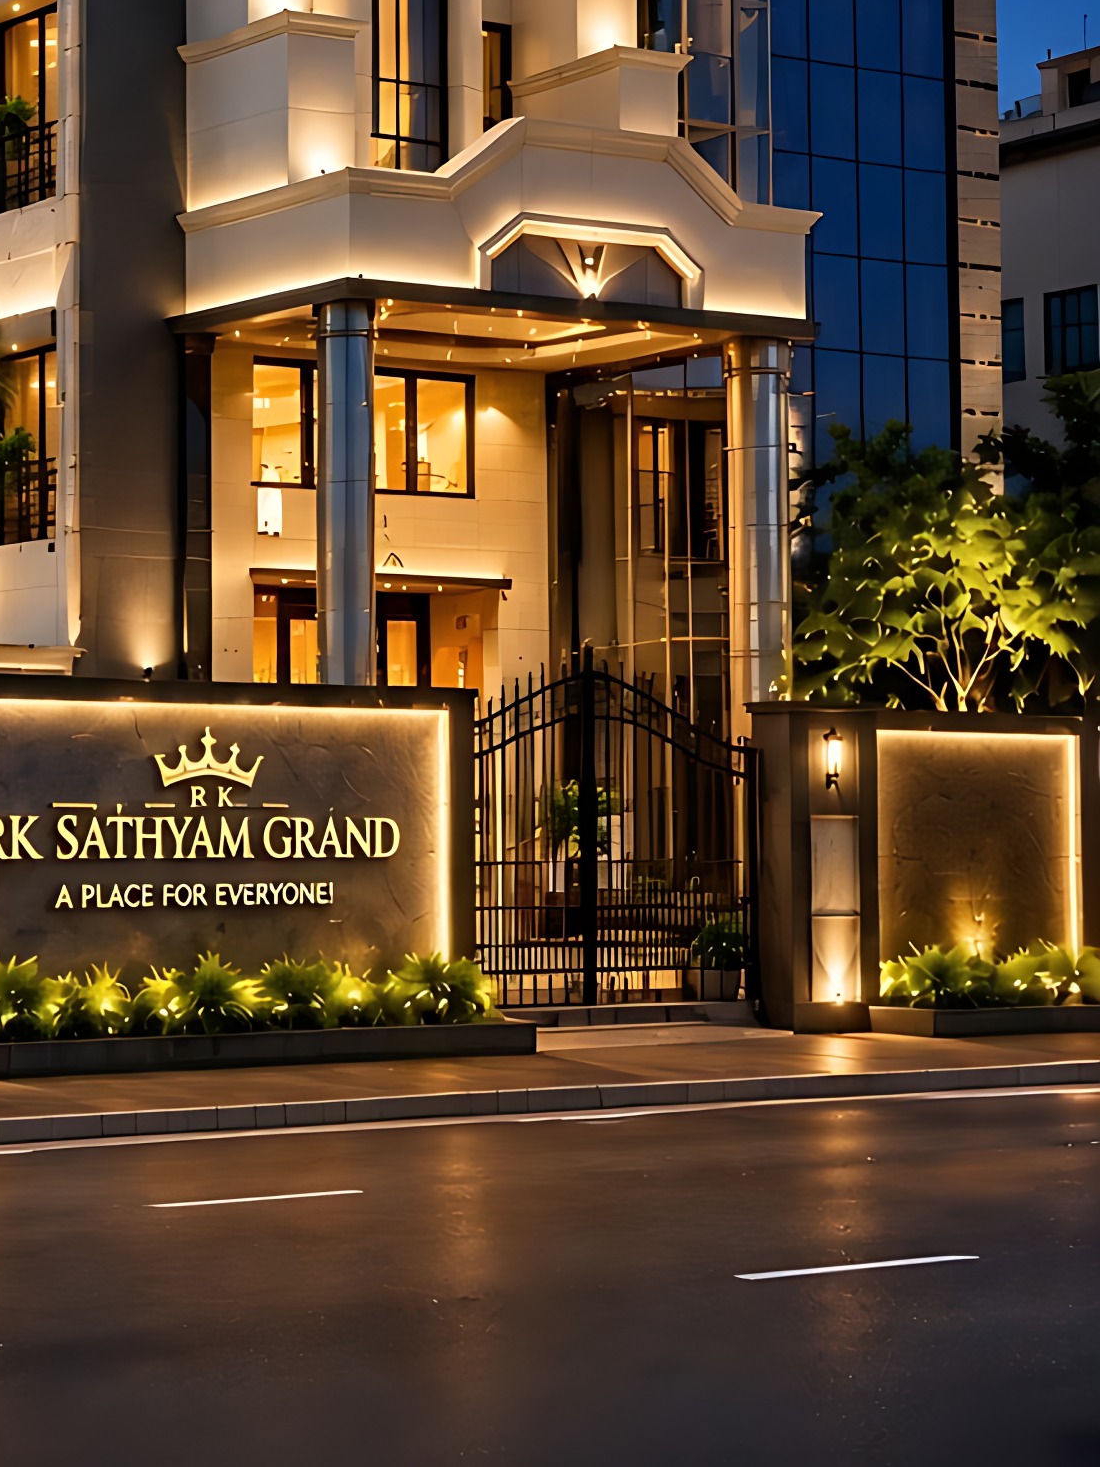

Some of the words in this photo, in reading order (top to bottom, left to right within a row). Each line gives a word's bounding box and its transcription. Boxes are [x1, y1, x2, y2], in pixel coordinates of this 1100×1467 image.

[56, 815, 255, 860] SATHYAM
[263, 815, 401, 859] GRAND
[55, 884, 73, 908] A
[81, 883, 154, 909] PLACE
[162, 883, 208, 907] FOR
[215, 881, 334, 907] EVERYONE!
